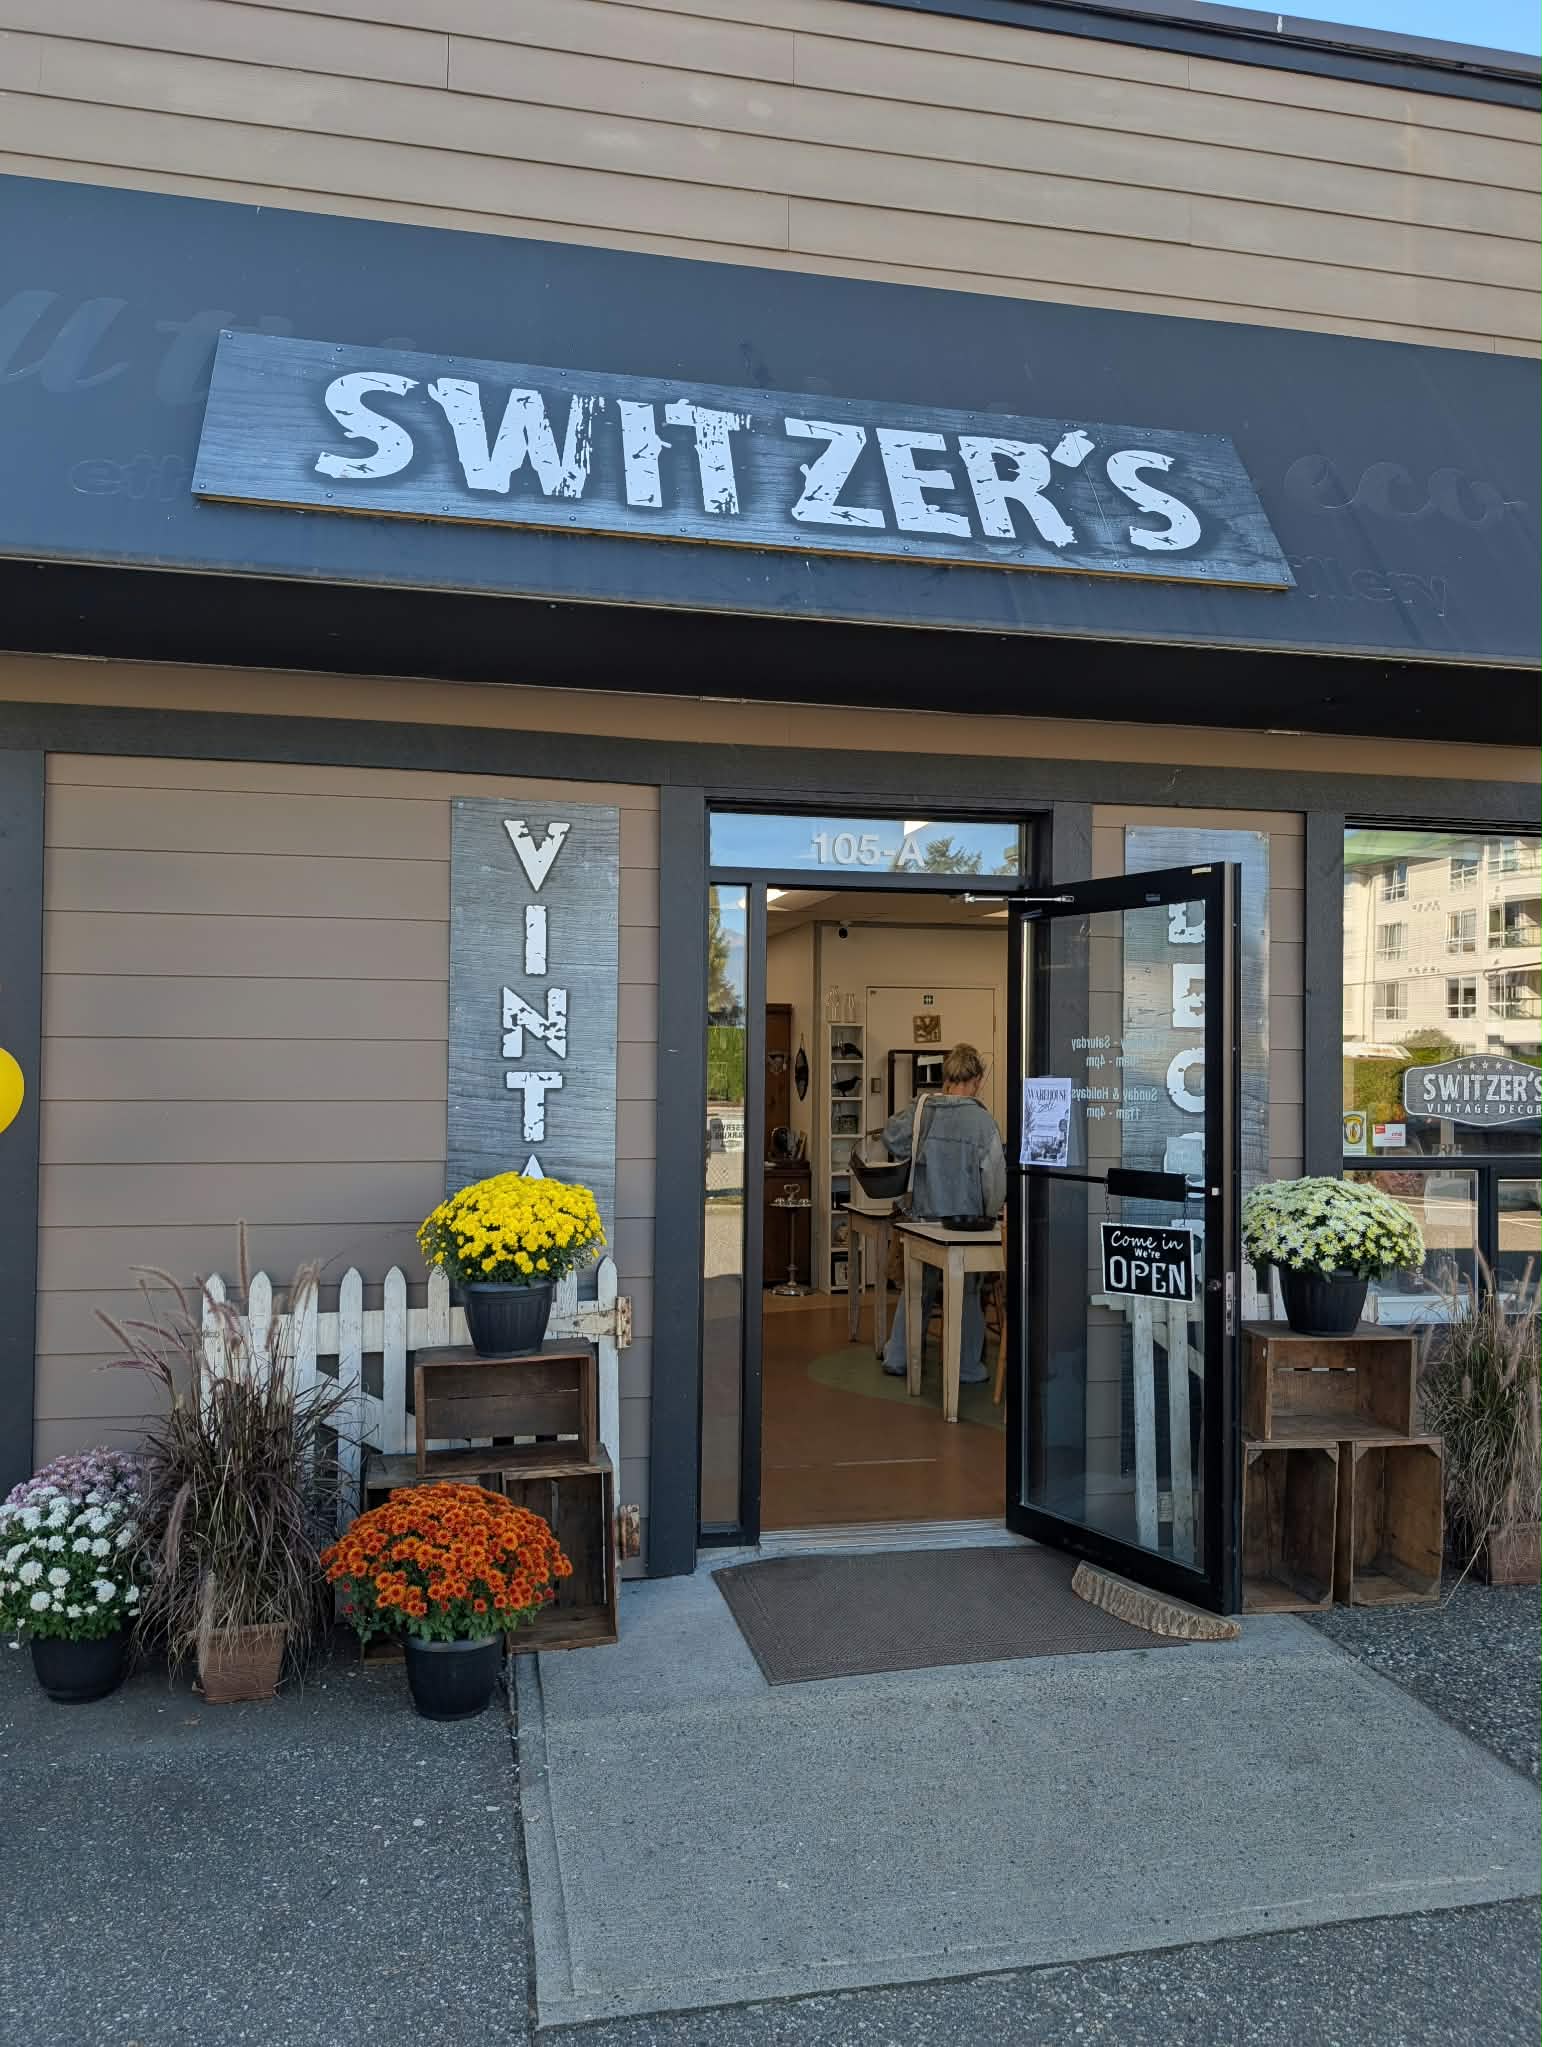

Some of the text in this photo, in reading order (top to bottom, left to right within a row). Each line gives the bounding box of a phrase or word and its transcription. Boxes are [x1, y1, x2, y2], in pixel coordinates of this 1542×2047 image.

[313, 370, 1202, 552] SWITZER'S
[811, 831, 925, 867] 105-A
[502, 819, 571, 1180] VINT
[1423, 1071, 1542, 1102] SWITZER'S
[1427, 1103, 1542, 1115] VINTAGE DECOR
[1111, 1230, 1184, 1250] Come in
[1134, 1247, 1161, 1259] We're
[1109, 1255, 1186, 1296] OPEN
